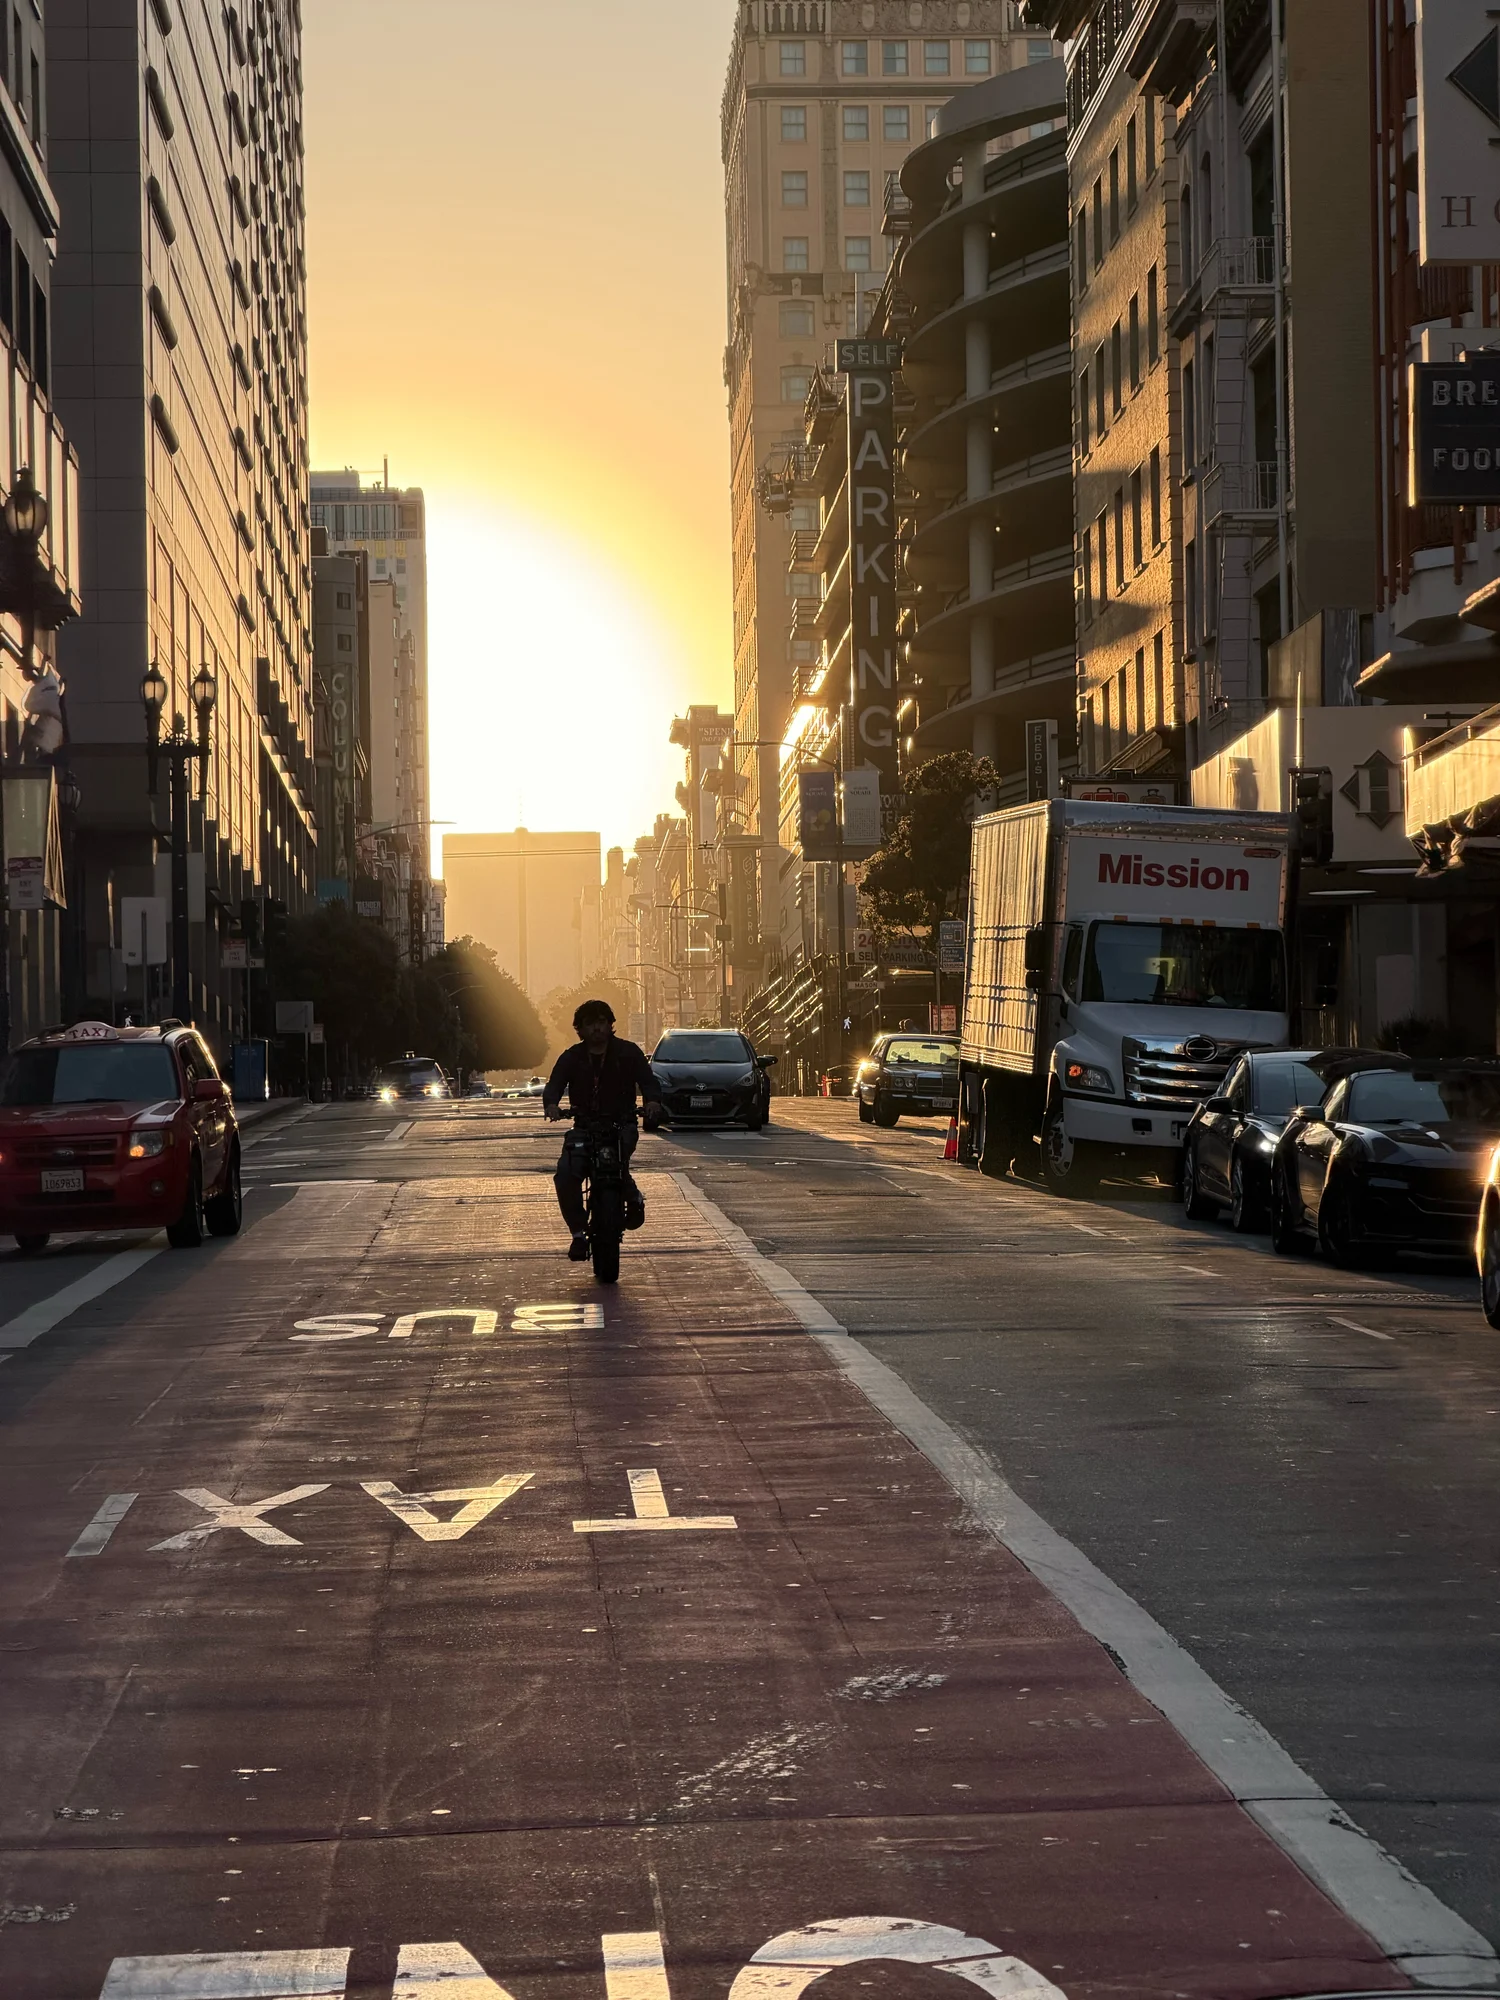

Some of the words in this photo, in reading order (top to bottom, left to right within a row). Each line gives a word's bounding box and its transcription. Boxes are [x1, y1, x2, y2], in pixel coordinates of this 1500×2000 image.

[841, 344, 898, 365] SELF
[1432, 447, 1500, 471] FOO
[853, 376, 893, 747] PARKING
[1034, 725, 1043, 775] FRED'S
[1098, 853, 1250, 892] Mission
[412, 891, 421, 962] GARLAND
[746, 880, 755, 946] SPERO
[858, 951, 875, 961] SEL
[69, 1027, 111, 1039] TAXI
[288, 1303, 605, 1343] BUS
[64, 1467, 739, 1558] TAXI
